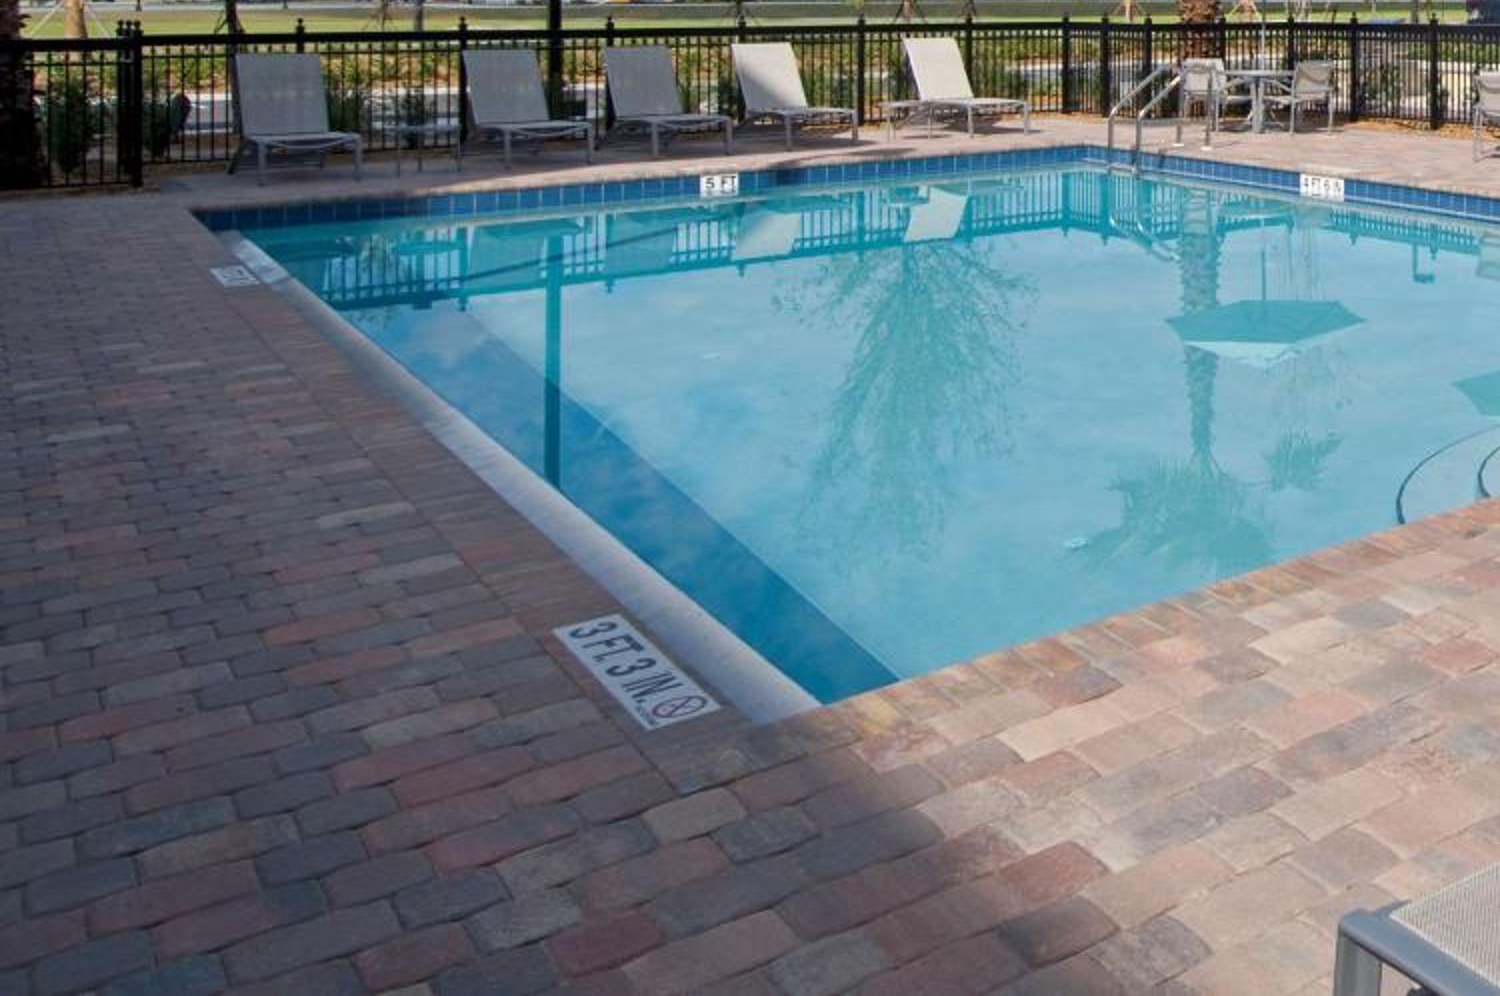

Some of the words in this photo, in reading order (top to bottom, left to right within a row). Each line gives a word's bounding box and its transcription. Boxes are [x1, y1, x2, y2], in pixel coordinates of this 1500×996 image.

[705, 177, 715, 189] 5
[569, 620, 618, 639] 3
[605, 657, 657, 678] 3
